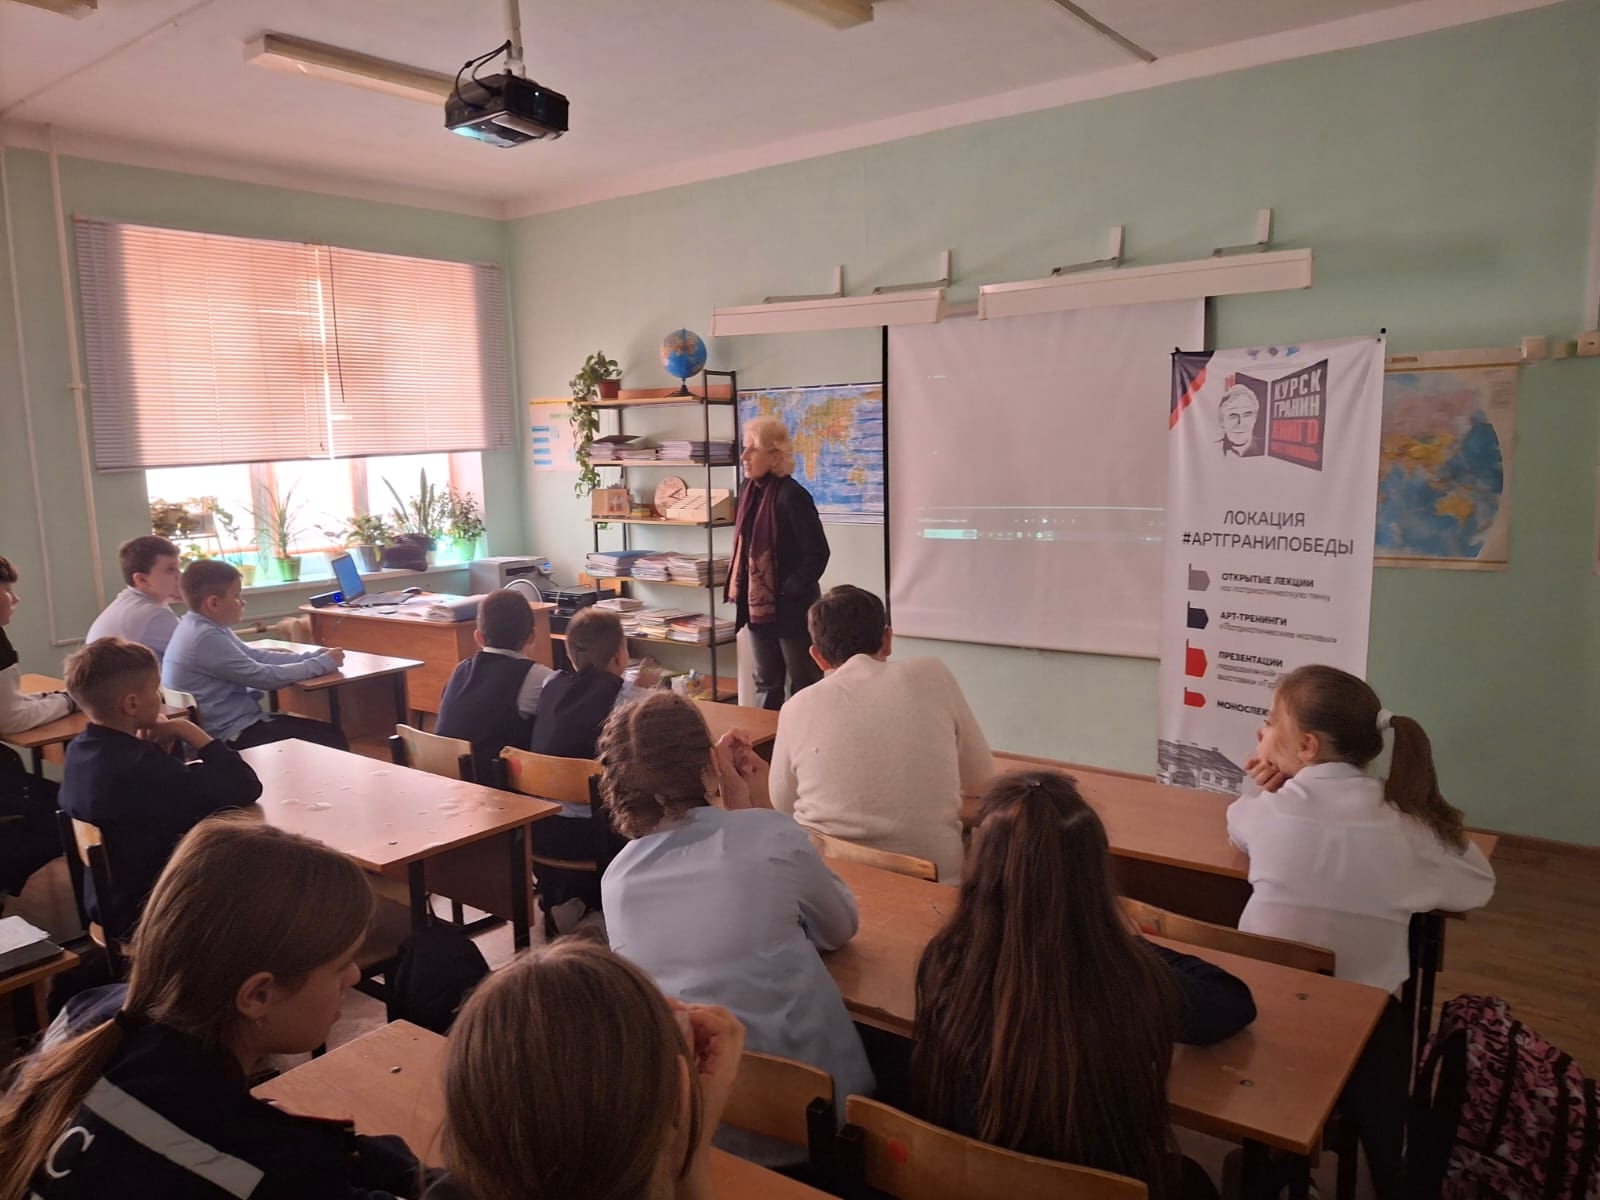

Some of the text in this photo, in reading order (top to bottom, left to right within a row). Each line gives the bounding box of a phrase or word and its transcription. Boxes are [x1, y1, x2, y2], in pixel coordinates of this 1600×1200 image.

[1274, 369, 1322, 401] КУРСК
[1273, 394, 1320, 418] ГРАНИН
[1223, 510, 1305, 530] ЛОКАЦИЯ
[1182, 531, 1354, 558] #АРТГРАНИПОБЕДЫ
[1221, 572, 1314, 588] ОТКРЫТЫЕ ЛЕКЦИИ
[1220, 612, 1288, 627] АРТ-ТРЕНИНГИ
[1218, 651, 1283, 668] ПРЕЗЕНТАЦИИ
[1216, 700, 1271, 717] МОНОСПЕК
